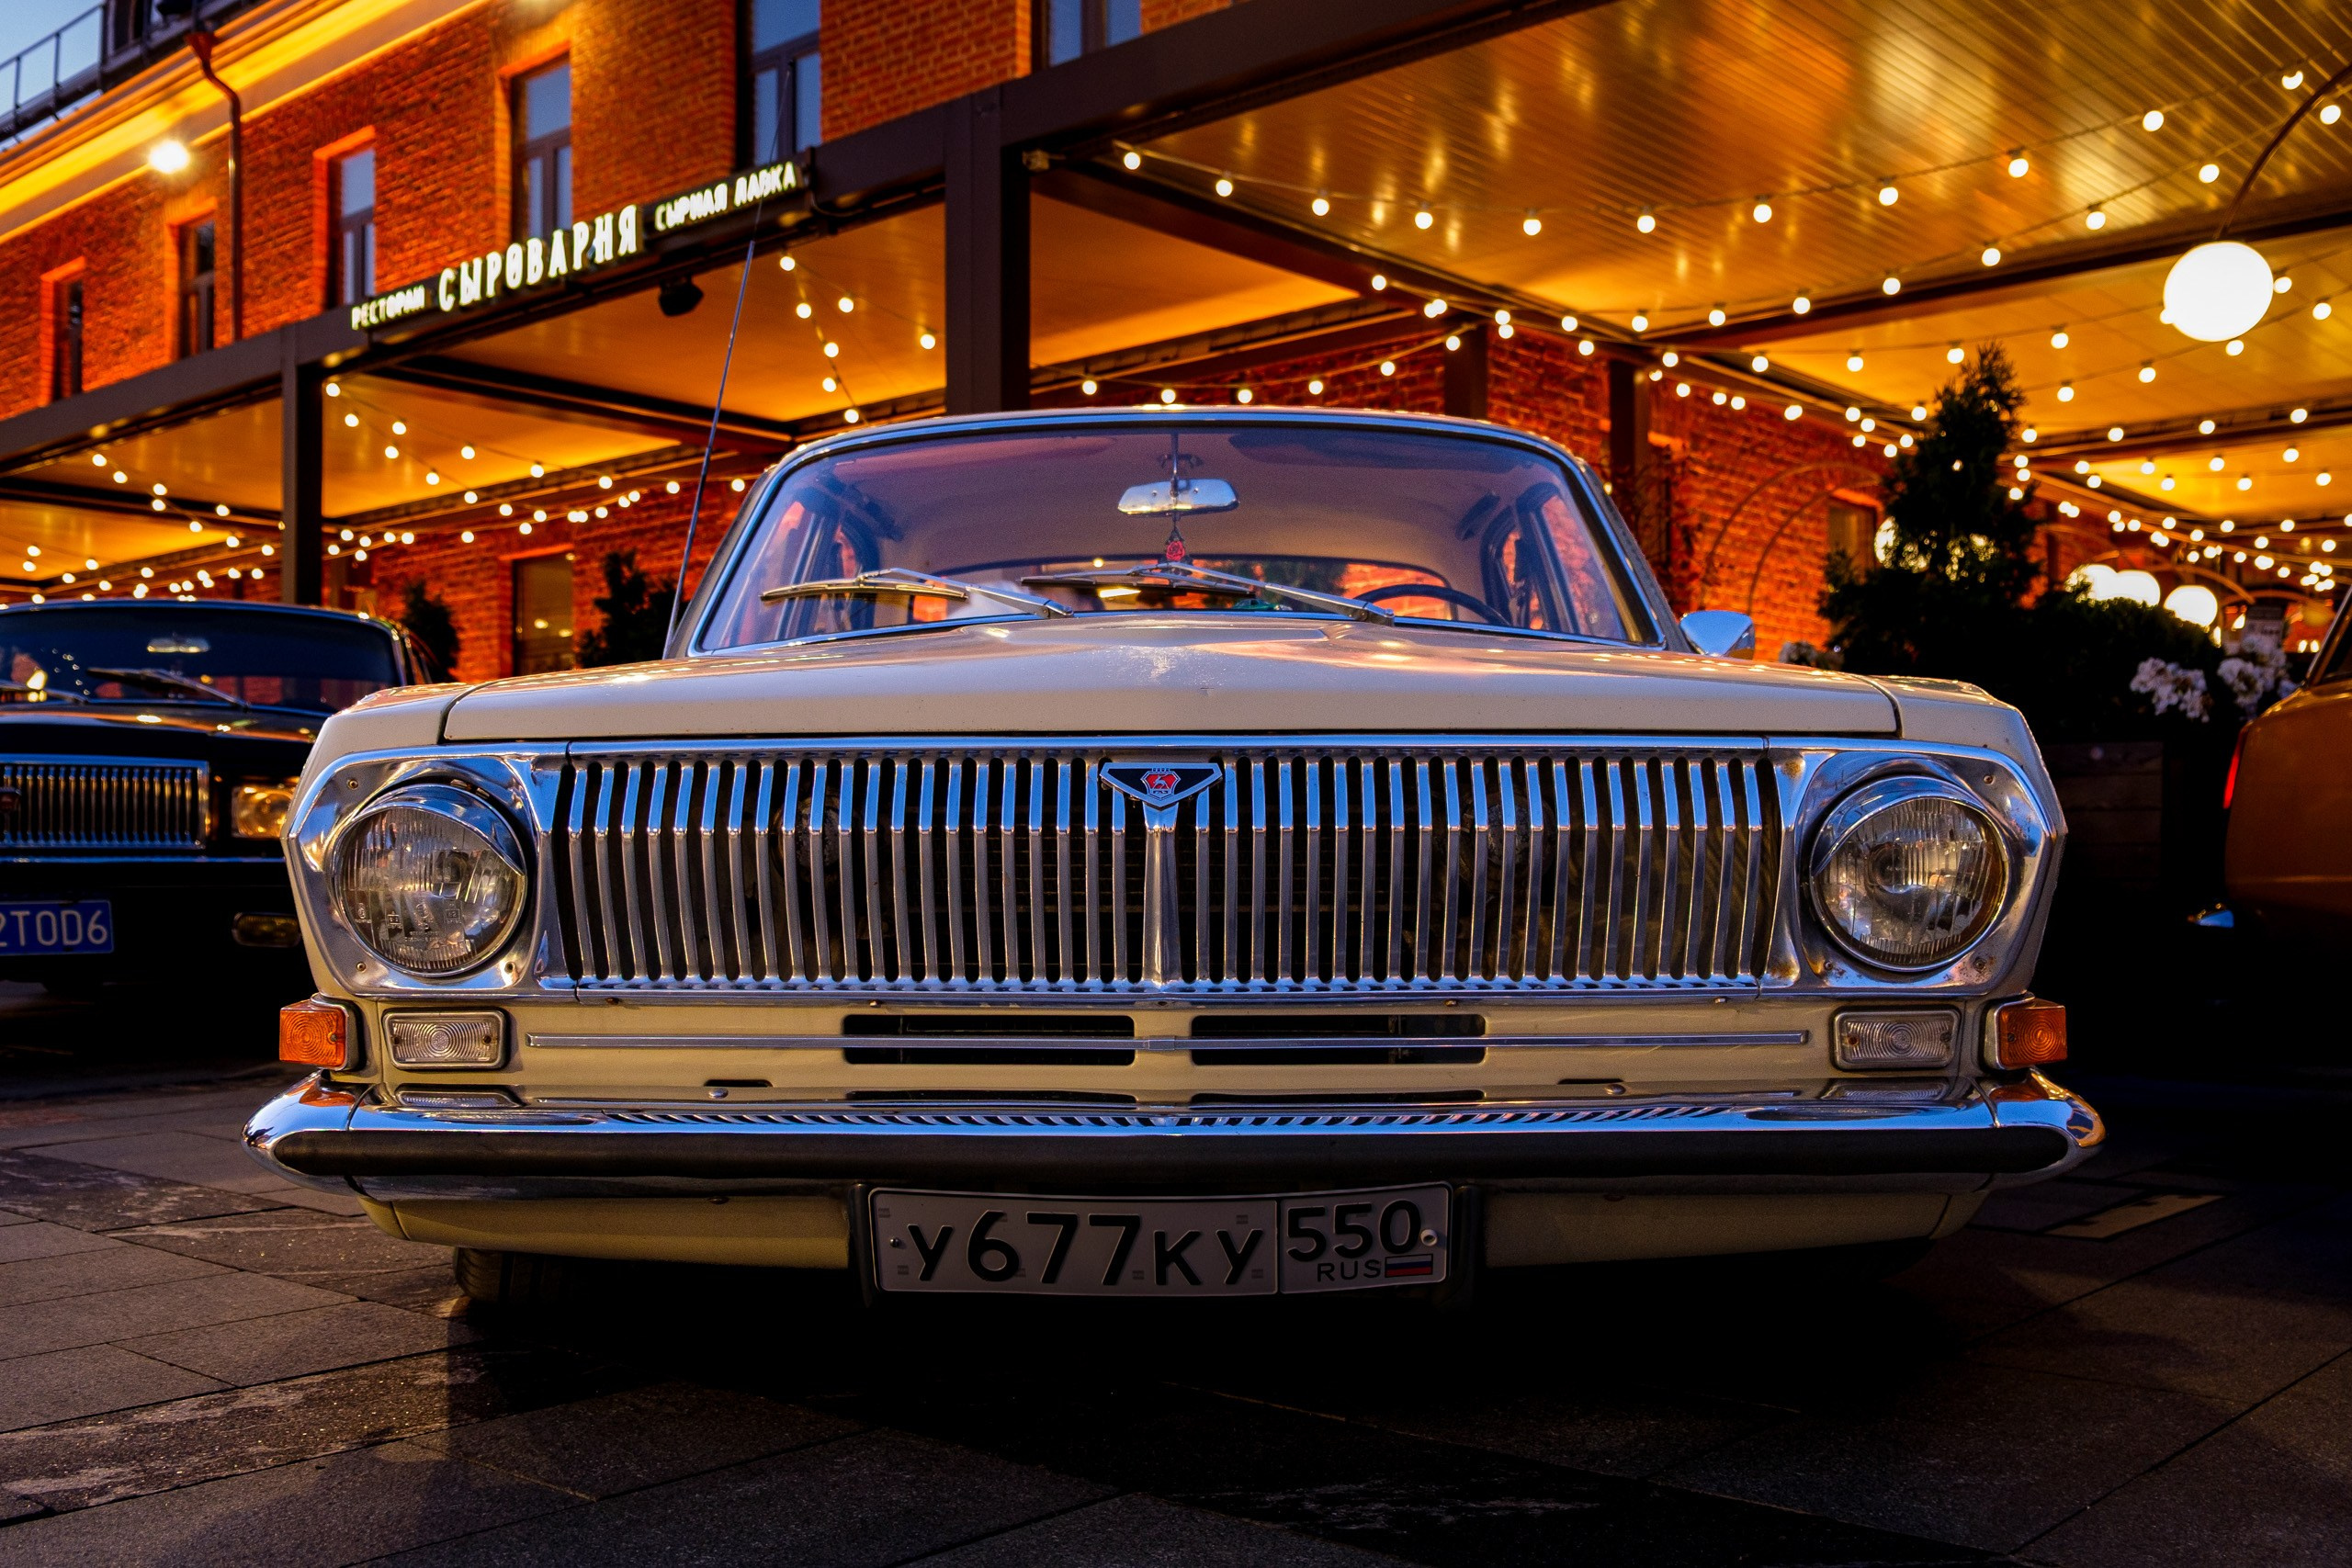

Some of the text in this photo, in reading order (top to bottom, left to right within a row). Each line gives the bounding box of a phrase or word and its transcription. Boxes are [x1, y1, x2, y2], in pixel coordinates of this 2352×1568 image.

[655, 162, 796, 231] СЫРНАЯ ЛАВКА
[352, 205, 637, 330] РЕСТОРАН СЫРОВАРНЯ
[1287, 1200, 1421, 1261] 550
[1317, 1259, 1381, 1282] RUS
